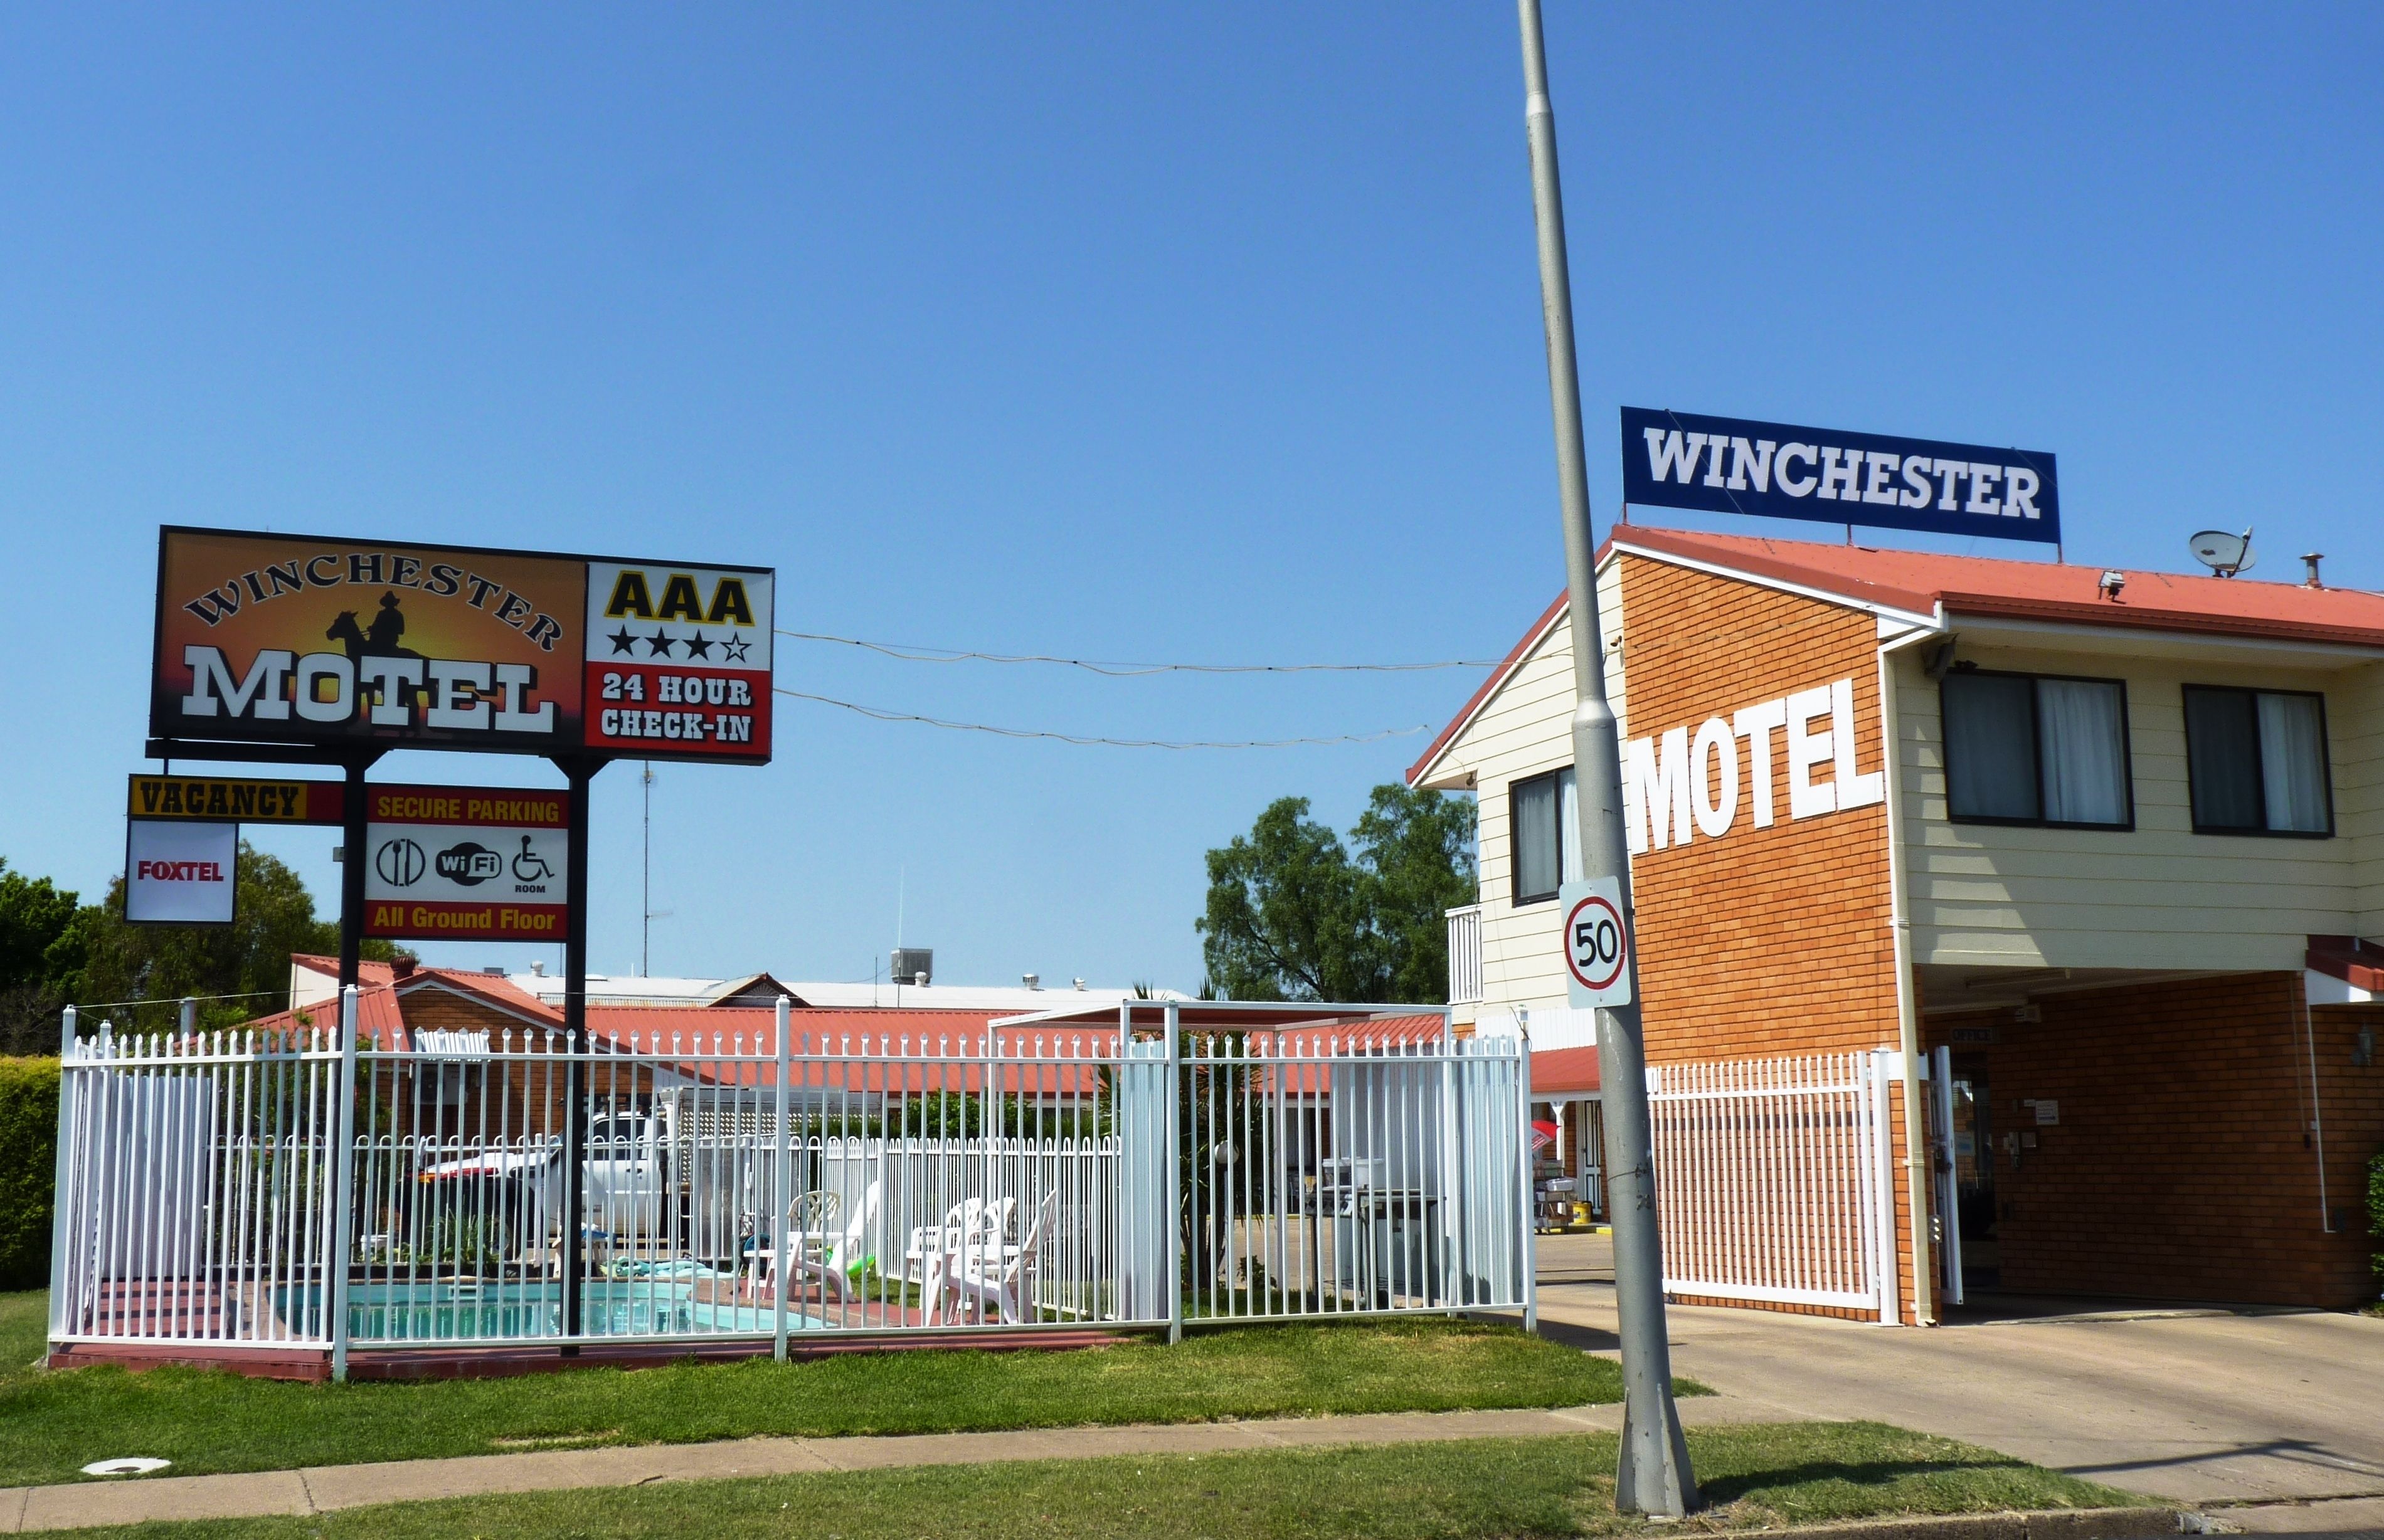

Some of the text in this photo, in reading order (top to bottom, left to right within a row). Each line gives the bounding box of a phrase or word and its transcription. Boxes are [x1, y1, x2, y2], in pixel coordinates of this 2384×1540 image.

[1643, 426, 2041, 520] WINCHESTER
[183, 553, 563, 652] WINCHESTER
[603, 569, 756, 627] AAA
[181, 644, 559, 734] MOTEL
[601, 672, 752, 706] 24 HOUR
[601, 708, 751, 742] CHECK-IN
[1627, 677, 1884, 856] MOTEL
[140, 781, 299, 817] VACANCY
[377, 796, 559, 823] SECURE PARKING
[137, 860, 225, 882] FOXTEL
[514, 884, 547, 894] ROOM
[373, 906, 556, 931] All Ground Floor
[1576, 919, 1618, 968] 50
[1952, 1028, 1991, 1042] OFFICE
